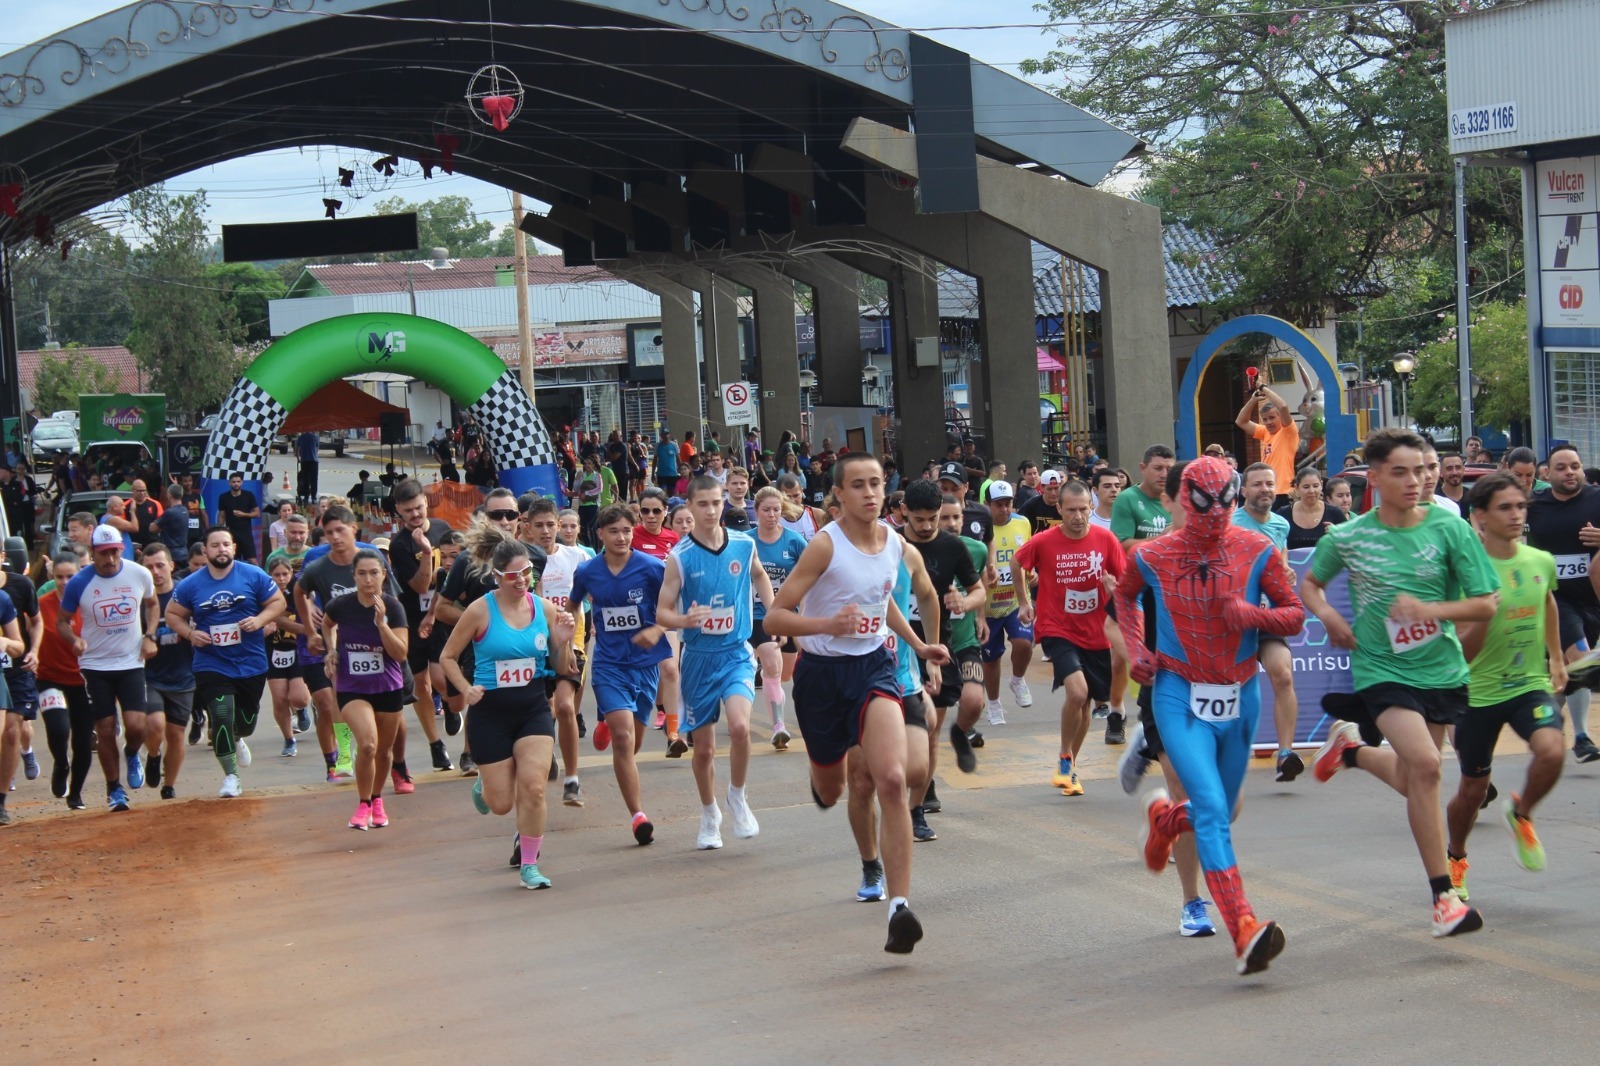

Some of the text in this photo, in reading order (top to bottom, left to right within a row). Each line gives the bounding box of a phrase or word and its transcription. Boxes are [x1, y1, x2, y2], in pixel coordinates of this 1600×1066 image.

[1460, 105, 1514, 134] 55 3329 1166
[1548, 169, 1584, 192] Vulcan
[1567, 192, 1584, 204] TRENT
[1559, 284, 1583, 309] CID
[368, 331, 406, 353] MG
[583, 345, 622, 356] DA CARNE
[1062, 552, 1088, 561] RÚSTICA
[1056, 561, 1079, 569] CIDADE
[1557, 562, 1588, 576] 736
[1056, 569, 1073, 577] MATO
[1056, 576, 1087, 584] QUEIMADO
[100, 602, 132, 619] TAG
[1067, 598, 1096, 611] 393
[606, 614, 638, 628] 486
[704, 615, 733, 631] 470
[213, 630, 239, 644] 374
[1395, 619, 1438, 645] 468
[274, 656, 294, 667] 481
[352, 659, 381, 673] 693
[500, 667, 533, 684] 410
[1196, 697, 1237, 717] 707
